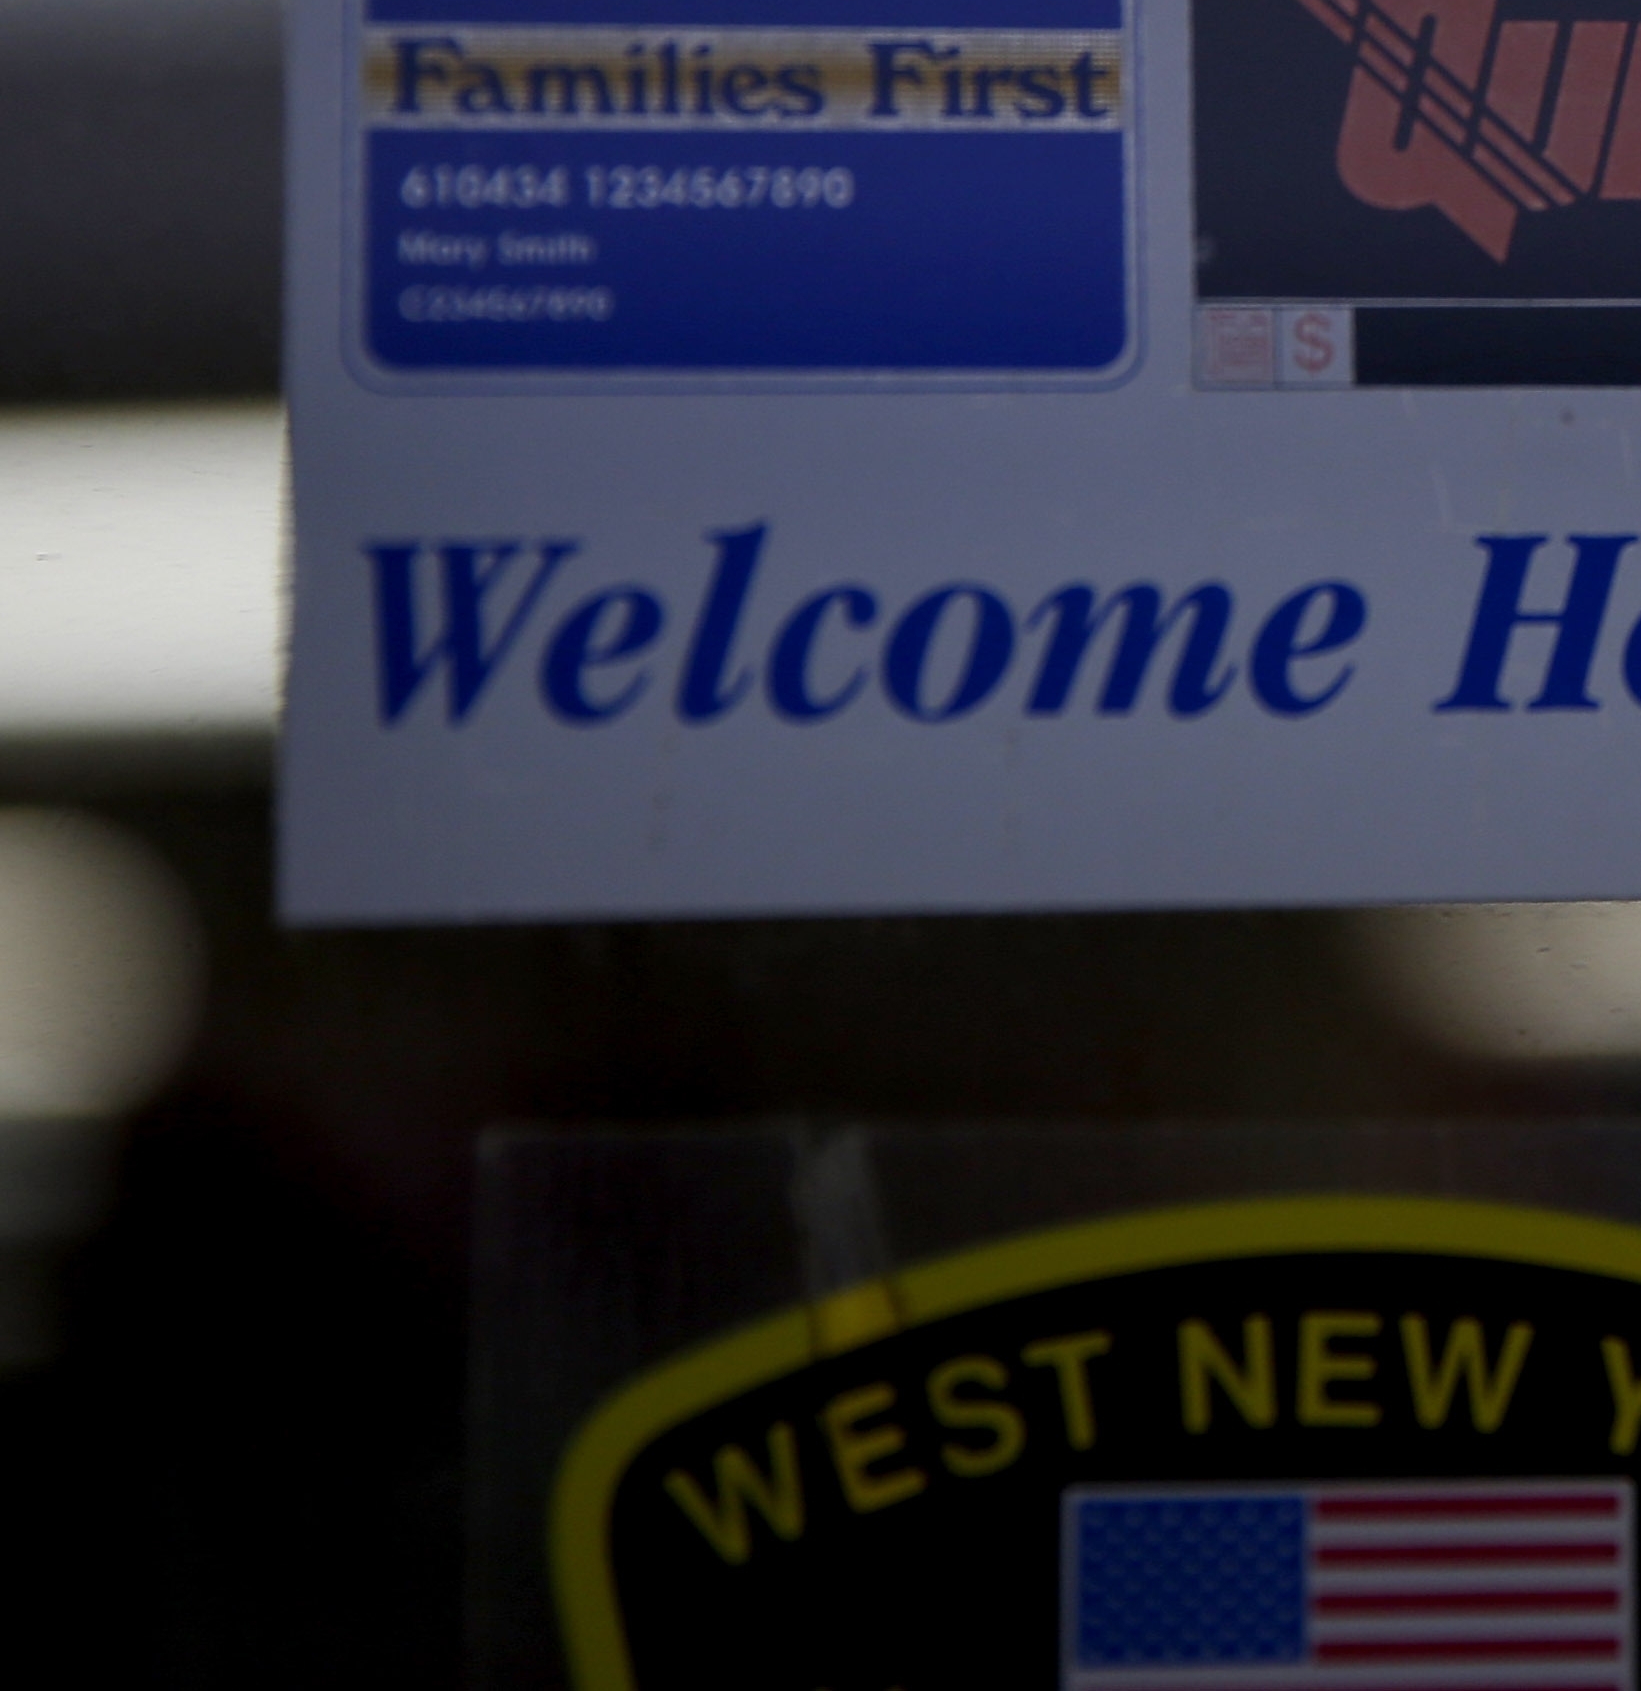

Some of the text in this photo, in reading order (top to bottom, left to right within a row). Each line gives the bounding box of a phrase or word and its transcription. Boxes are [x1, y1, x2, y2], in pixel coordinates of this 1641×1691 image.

[390, 36, 1114, 120] Families First
[400, 162, 857, 210] 610434 1234567890
[398, 229, 598, 270] Mary Smith
[361, 521, 1370, 729] Welcome
[662, 1330, 1114, 1565] WEST
[1179, 1312, 1534, 1435] NEW
